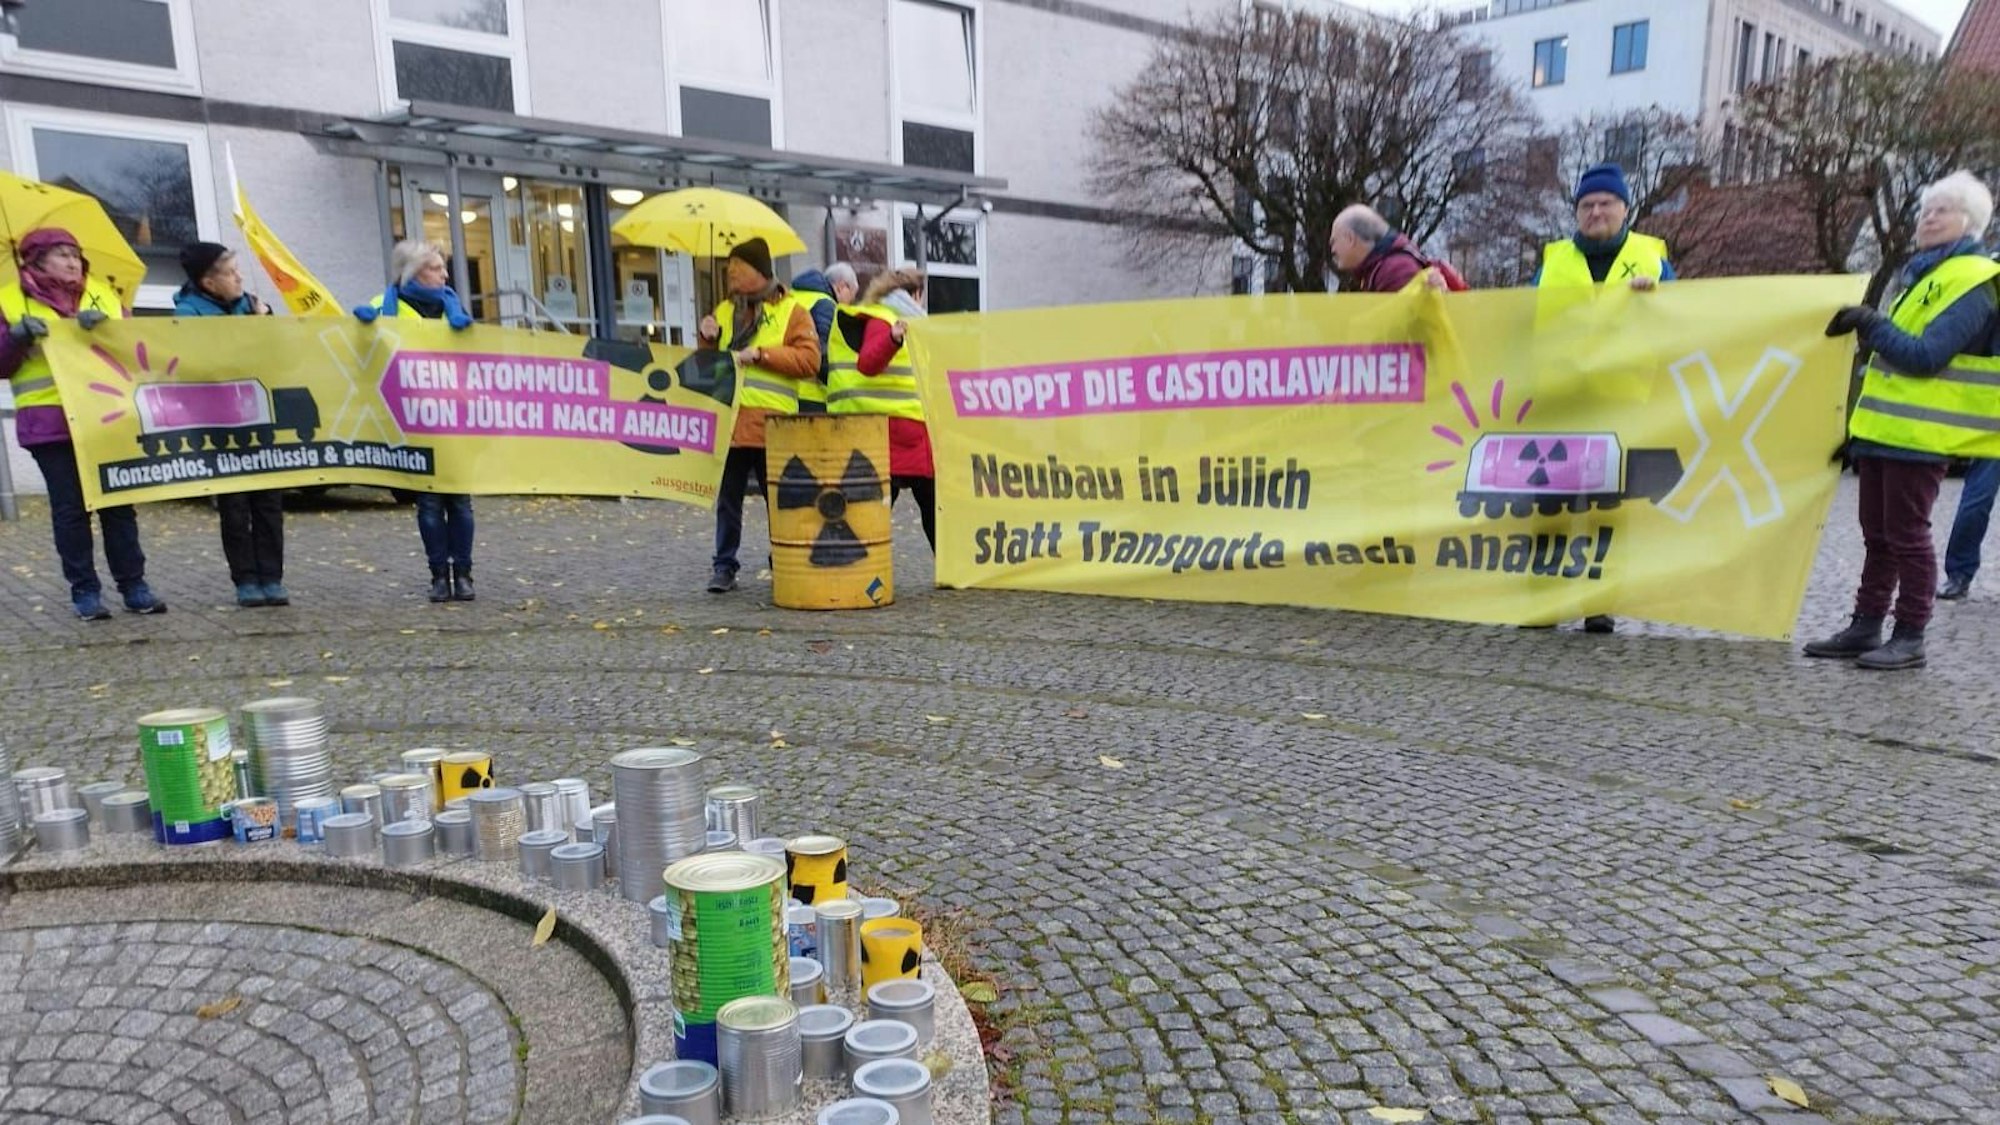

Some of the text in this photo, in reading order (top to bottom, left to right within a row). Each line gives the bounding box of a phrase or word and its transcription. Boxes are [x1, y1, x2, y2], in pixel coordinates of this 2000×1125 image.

[398, 358, 600, 396] KEIN ATOMMÜLL
[958, 352, 1411, 412] STOPPT DIE CASTORLAWINE!
[400, 395, 709, 446] VON JÜLICH NACH AHAUS!
[106, 445, 428, 489] Konzeptlos, überflüssig & gefährlich
[969, 452, 1312, 510] Neubau in Jülich
[974, 520, 1063, 565] statt
[1078, 520, 1287, 574] Transporte
[1303, 536, 1417, 567] nach
